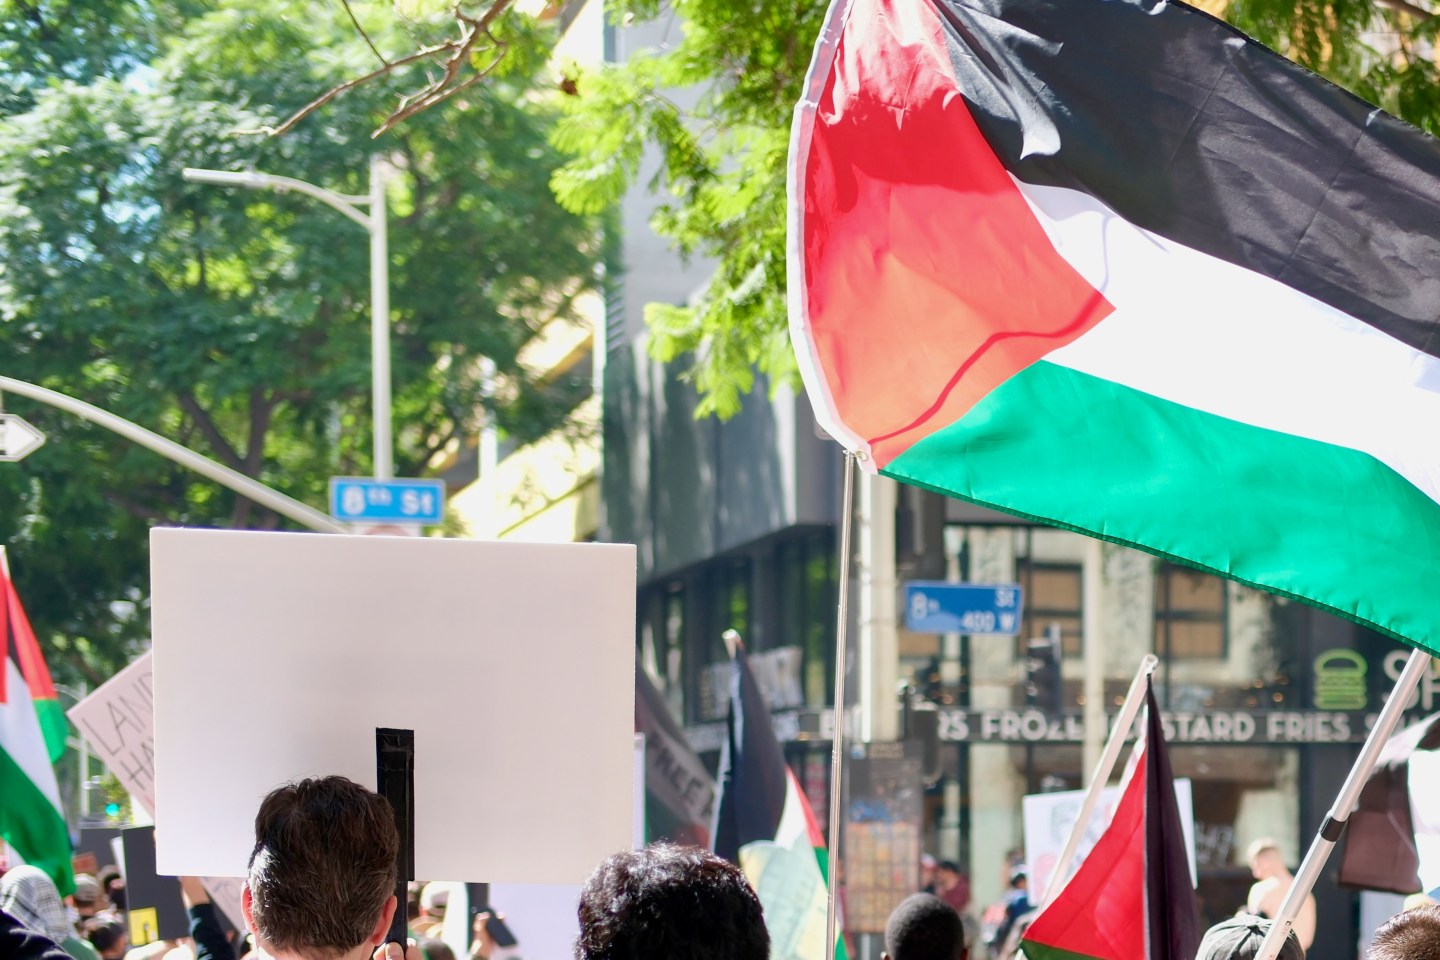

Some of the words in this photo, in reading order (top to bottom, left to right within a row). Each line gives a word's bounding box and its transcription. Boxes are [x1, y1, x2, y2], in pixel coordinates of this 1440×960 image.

[401, 488, 433, 515] St
[995, 587, 1014, 607] St
[962, 611, 995, 632] 400
[1267, 711, 1350, 740] FRIES
